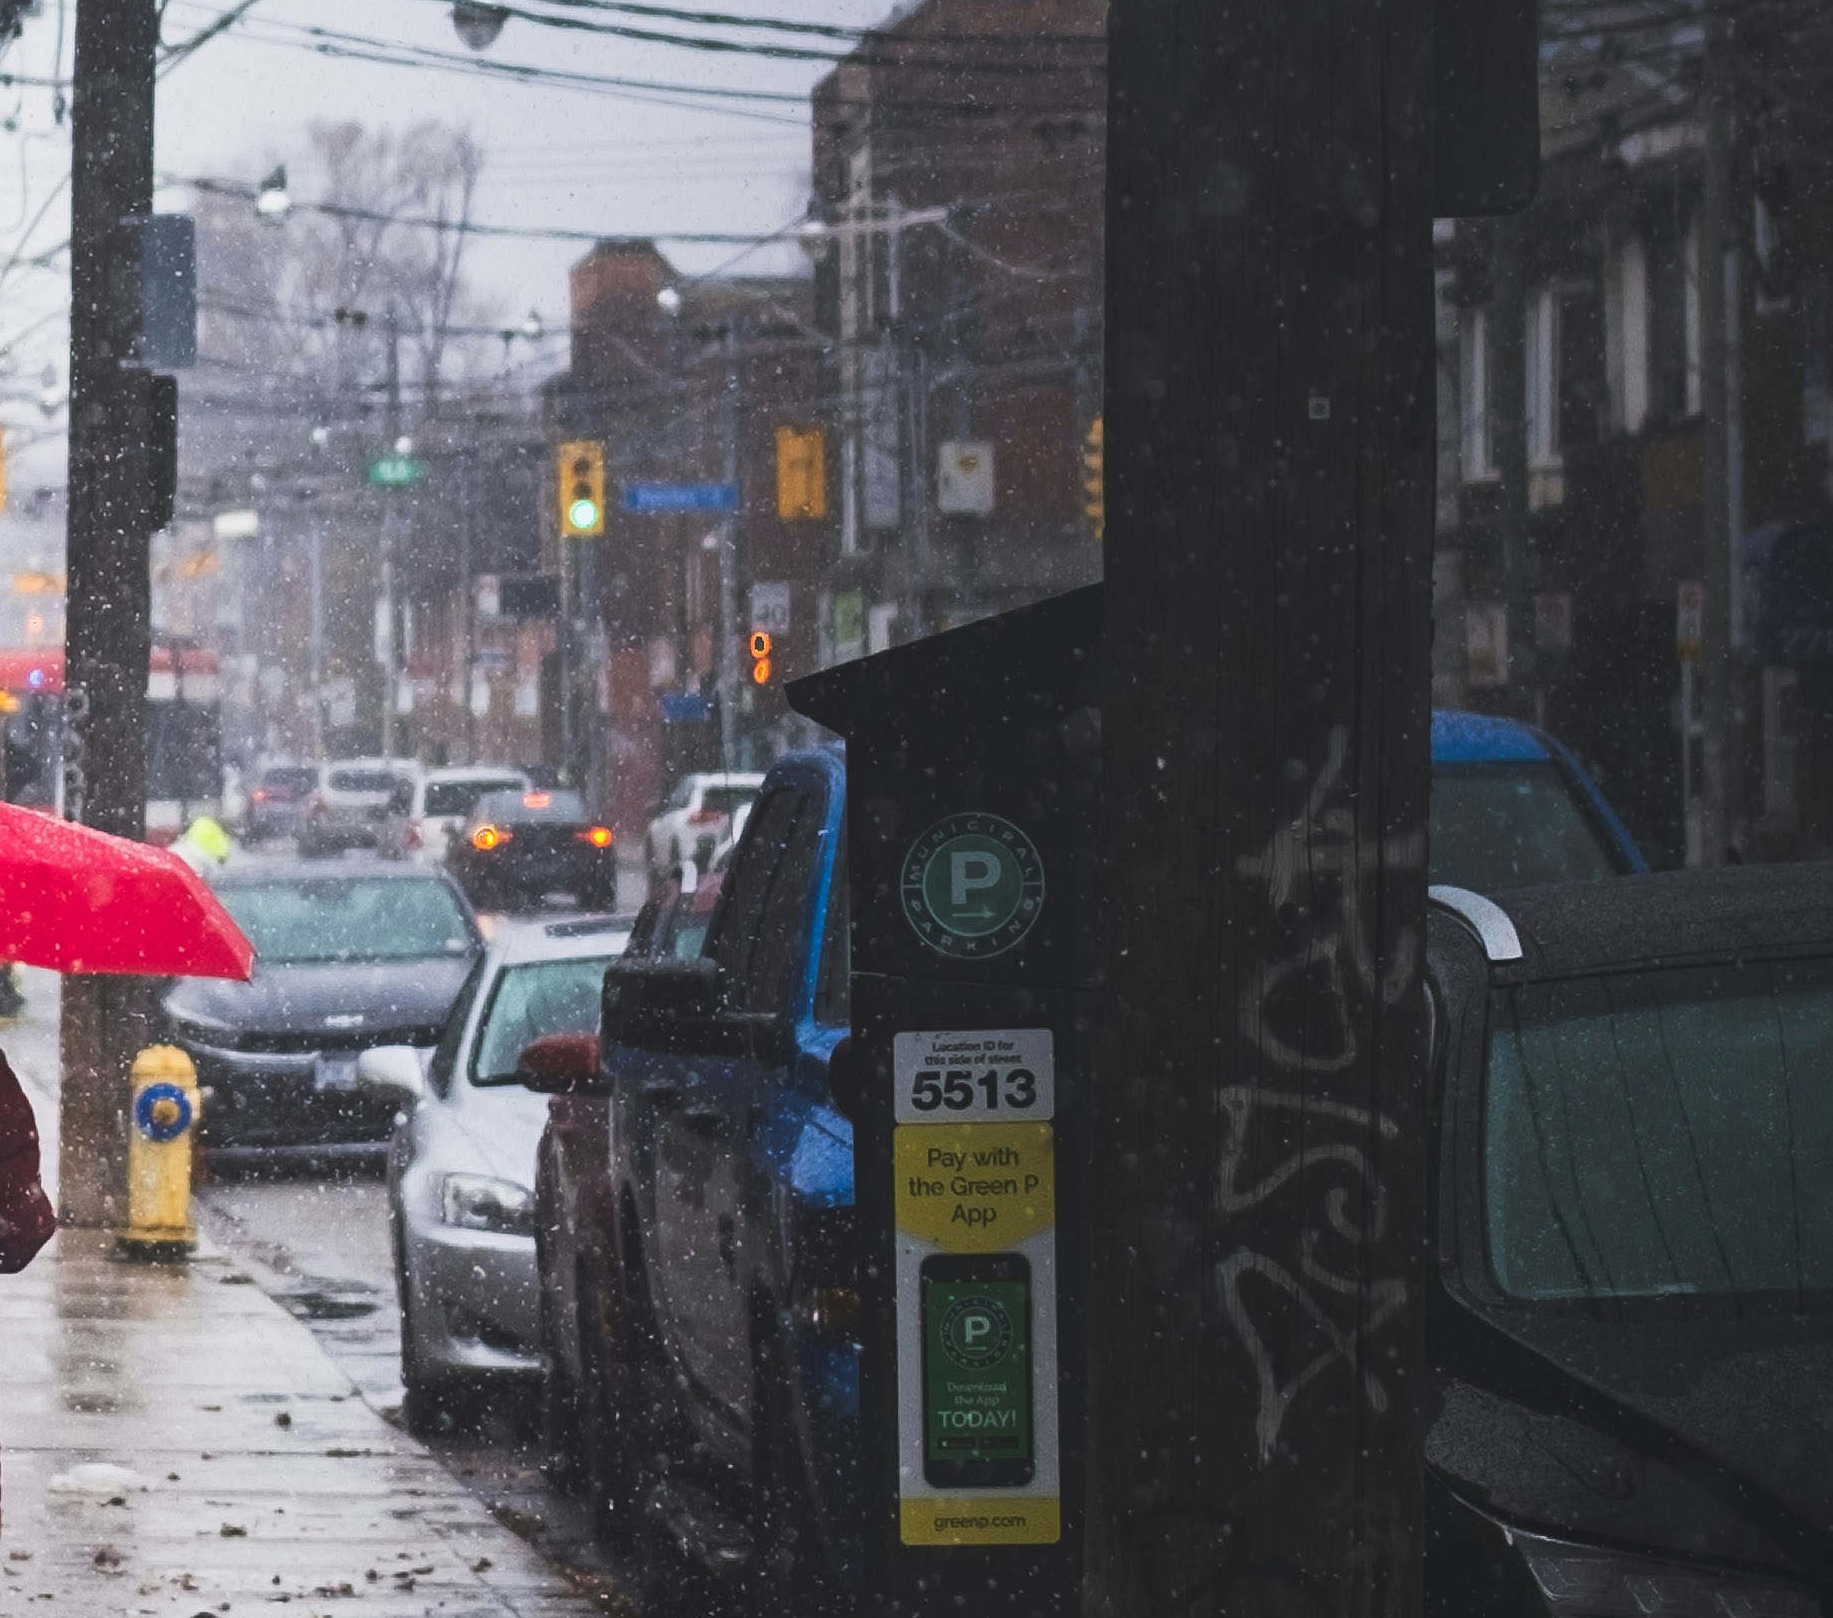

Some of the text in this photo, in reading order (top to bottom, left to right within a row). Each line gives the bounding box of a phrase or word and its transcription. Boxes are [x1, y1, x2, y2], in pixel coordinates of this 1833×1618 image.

[910, 820, 1034, 881] MUNICIPAL
[951, 851, 1001, 904] P
[911, 897, 1034, 950] PARKING
[932, 1040, 1015, 1053] Location ID for
[925, 1054, 945, 1065] this
[948, 1054, 972, 1065] side
[974, 1053, 987, 1064] of
[911, 1068, 1037, 1111] 5513
[928, 1147, 1019, 1171] Pay with
[909, 1174, 1039, 1197] the Green P
[951, 1204, 997, 1227] App
[965, 1316, 991, 1343] P
[947, 1381, 1007, 1393] Download
[954, 1395, 1000, 1407] the App
[937, 1410, 1017, 1428] TODAY!
[934, 1515, 1027, 1531] greenp.com
